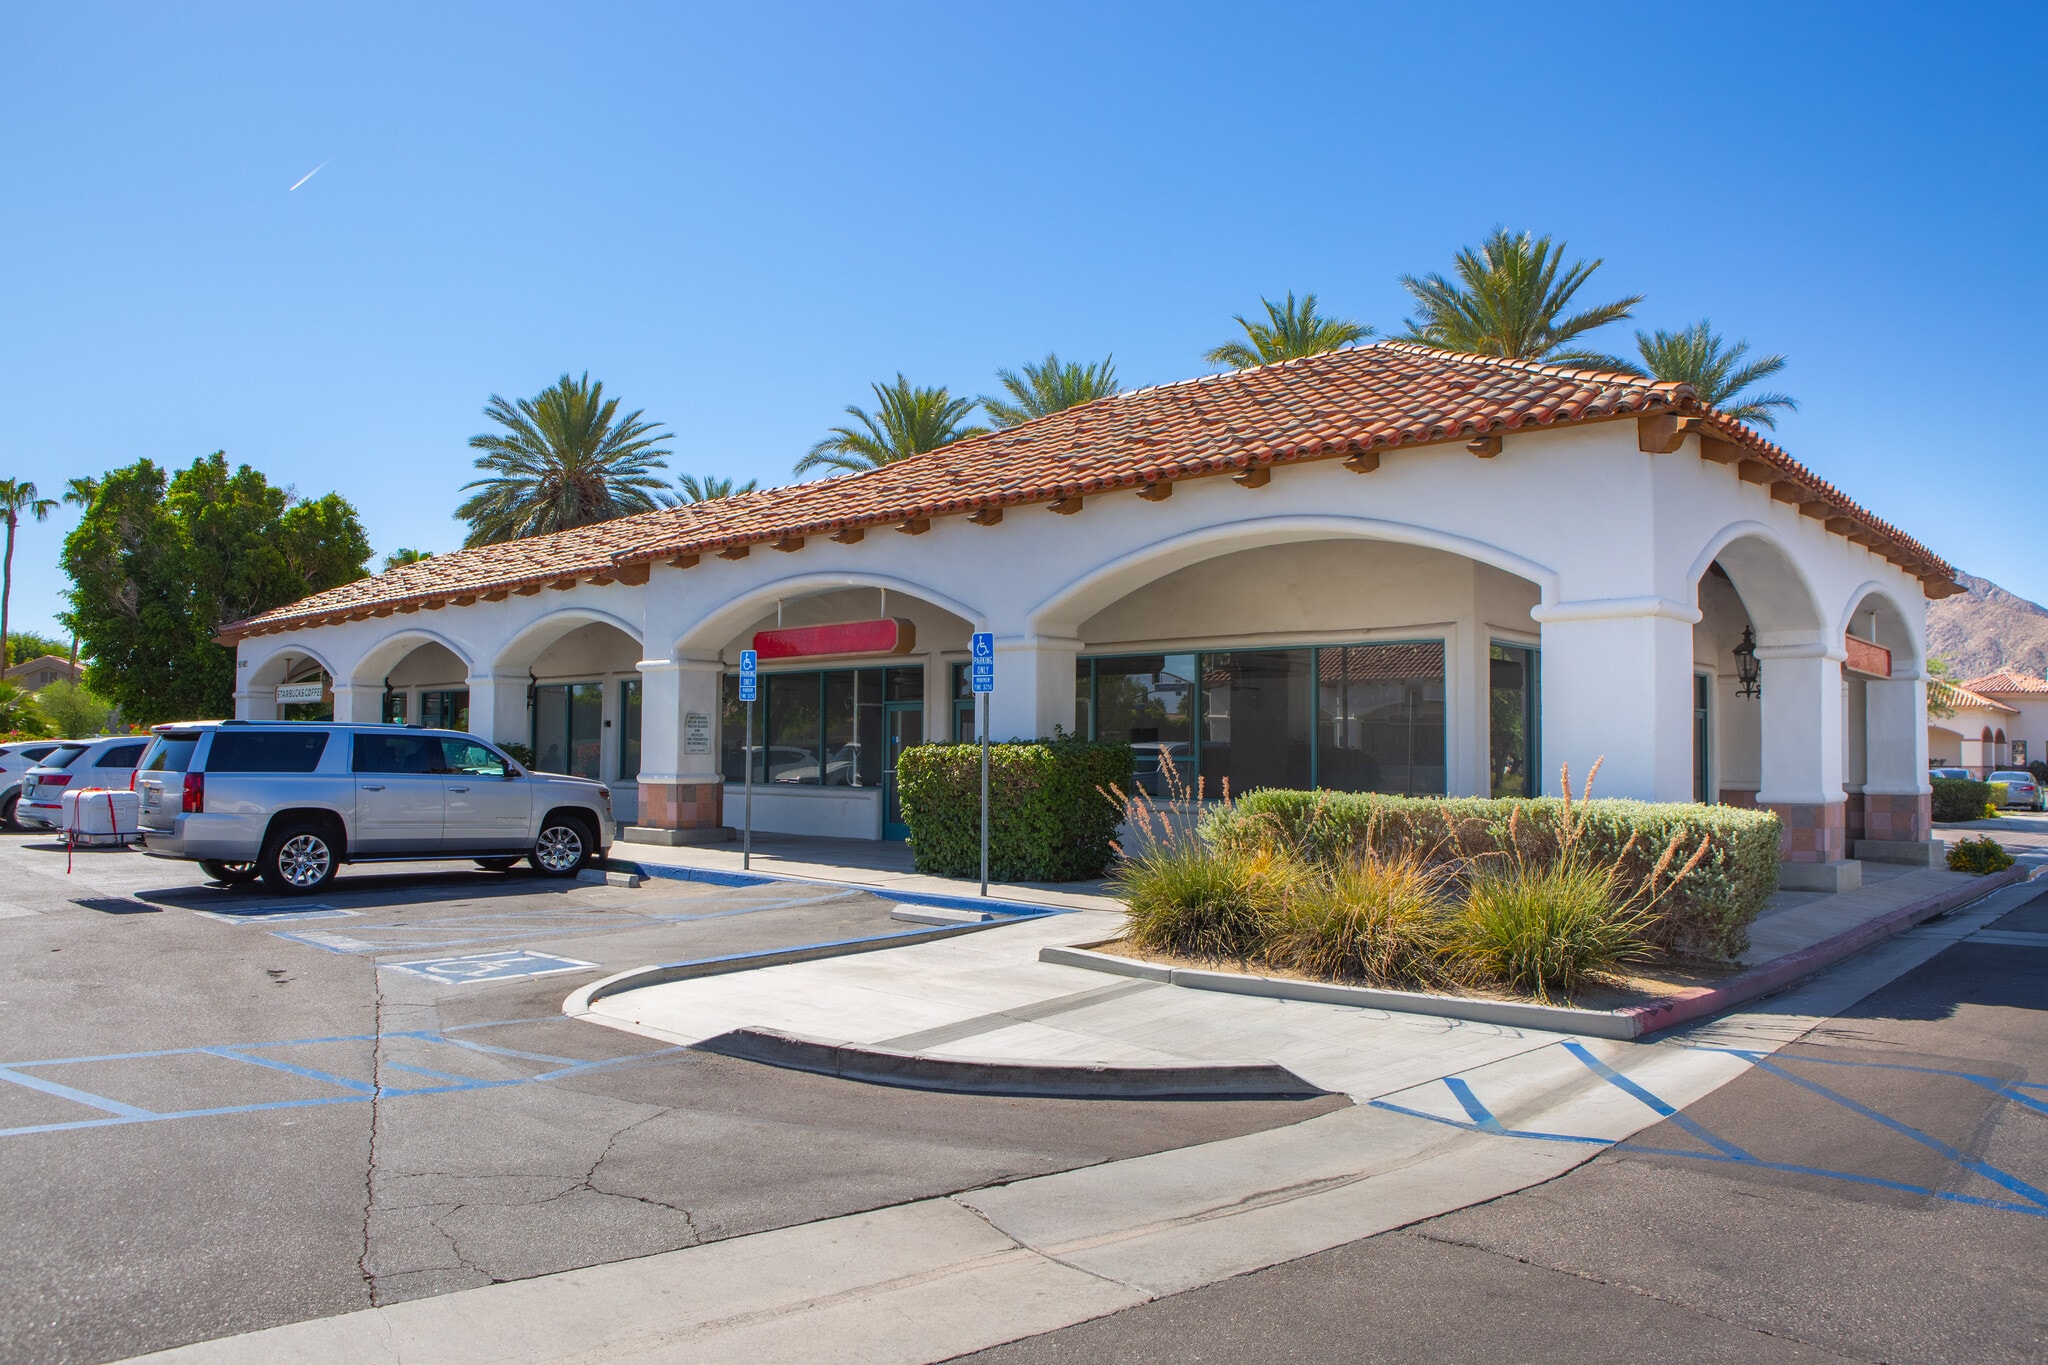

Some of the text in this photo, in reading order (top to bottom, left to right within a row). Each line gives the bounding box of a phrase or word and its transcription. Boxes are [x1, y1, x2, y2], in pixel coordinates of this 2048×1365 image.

[977, 665, 989, 675] ONLY
[277, 687, 322, 698] STARBUCKS COFFEE
